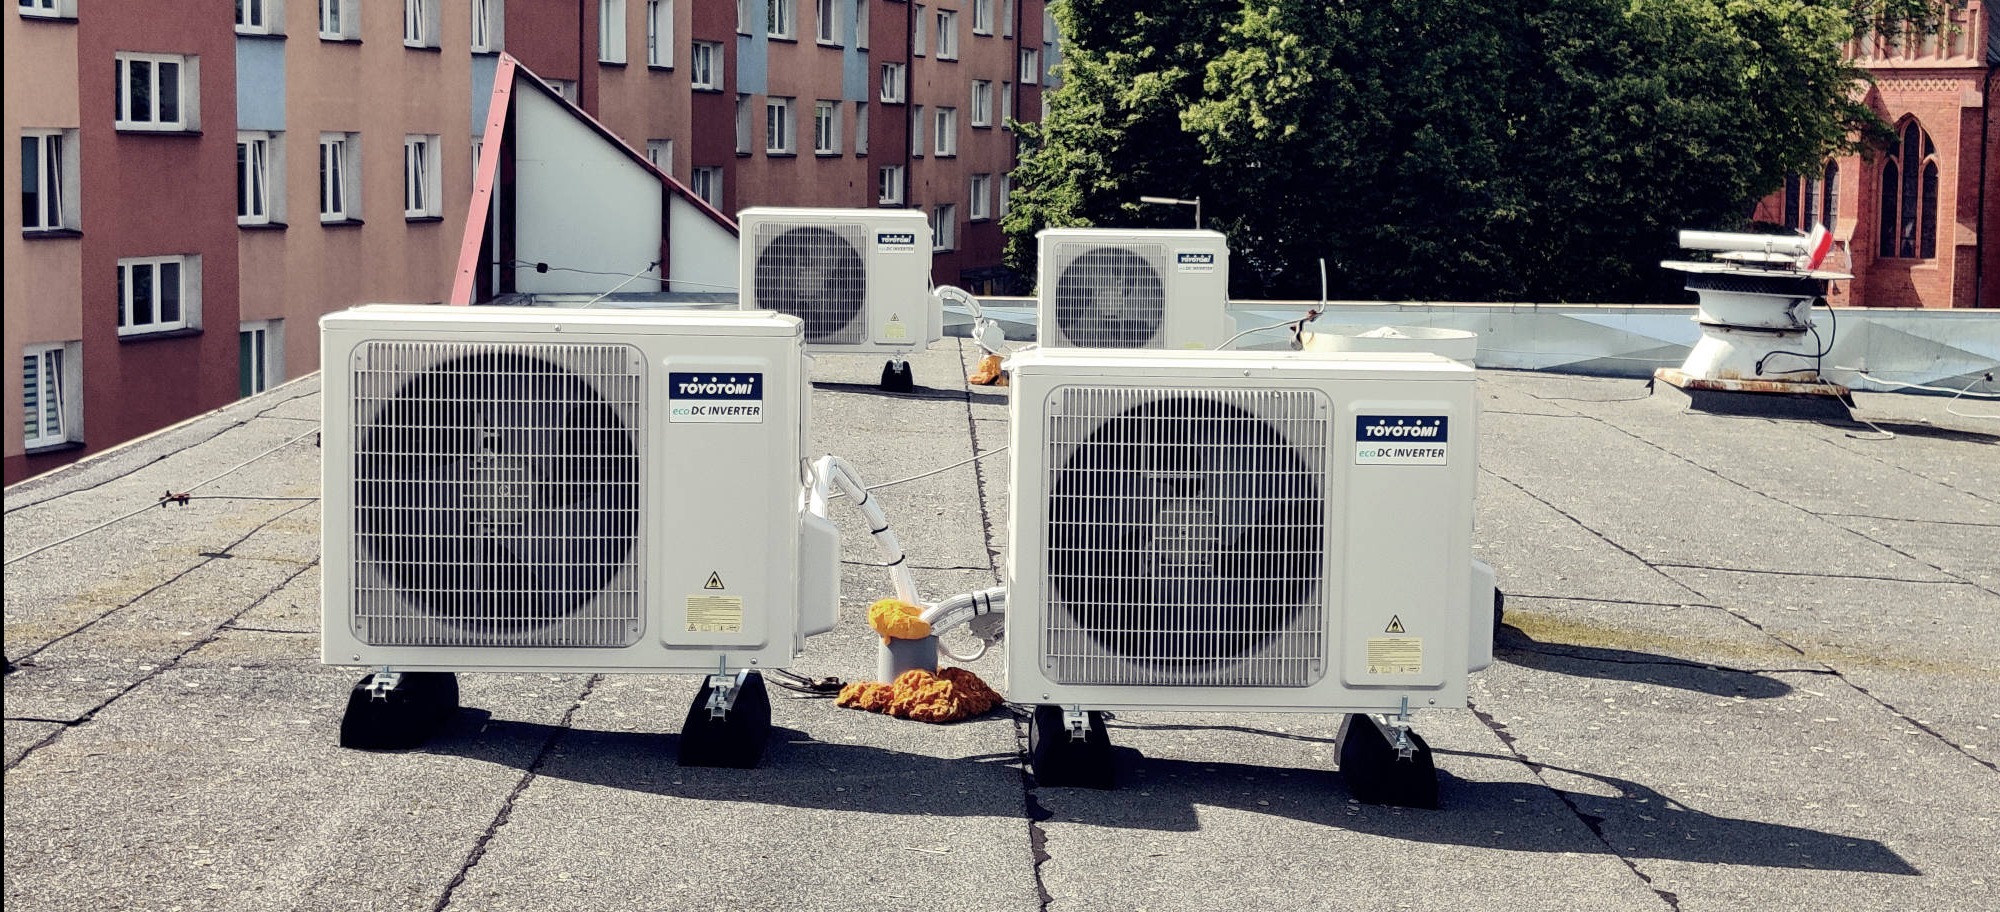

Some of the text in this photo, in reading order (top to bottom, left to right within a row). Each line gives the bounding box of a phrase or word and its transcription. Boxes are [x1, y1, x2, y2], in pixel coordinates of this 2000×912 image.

[691, 406, 706, 415] DC
[708, 406, 760, 415] INVERTER
[1377, 448, 1392, 457] DC
[1394, 448, 1444, 457] INVERTER
